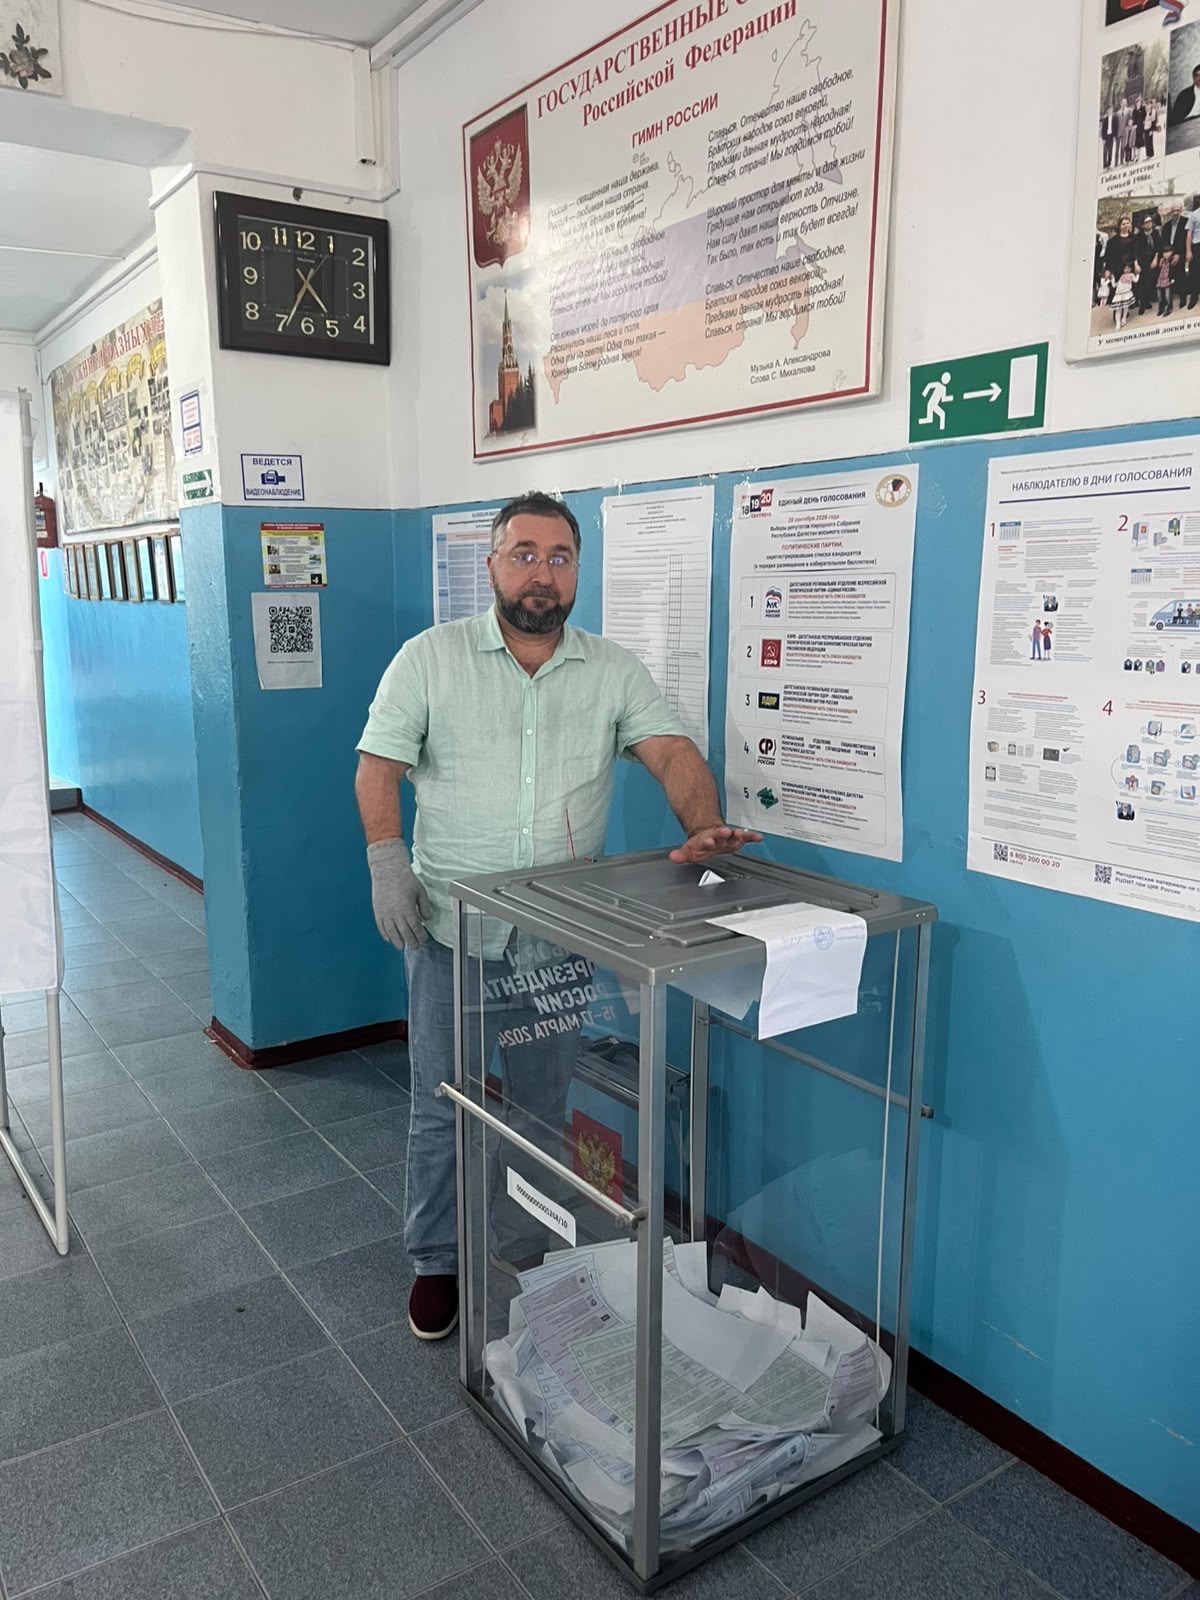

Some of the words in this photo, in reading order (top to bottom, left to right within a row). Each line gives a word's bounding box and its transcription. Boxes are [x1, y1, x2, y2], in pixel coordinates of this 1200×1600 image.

[538, 0, 729, 119] ГОСУДАРСТВЕННЫЕ
[583, 57, 675, 127] Российской
[685, 0, 797, 70] Федерации
[740, 100, 784, 128] Отечество
[786, 89, 807, 107] наше
[809, 69, 854, 97] свободное,
[632, 120, 663, 149] ГИМН
[667, 93, 719, 137] РОССИИ
[743, 121, 773, 143] народов
[774, 113, 793, 132] союз
[708, 151, 742, 174] Предками
[743, 139, 768, 161] данная
[770, 123, 809, 149] мудрость
[811, 99, 852, 128] народная!
[739, 152, 769, 175] страна!
[770, 148, 783, 161] Мы
[785, 132, 822, 156] гордимся
[824, 116, 854, 139] тобой!
[577, 184, 610, 206] священная
[611, 176, 628, 190] наша
[707, 197, 737, 219] Широкий
[738, 187, 770, 208] простор
[771, 180, 785, 196] для
[786, 169, 814, 189] мечты
[816, 167, 821, 176] и
[822, 159, 838, 175] для
[839, 148, 865, 167] жизни
[1107, 181, 1130, 191] семьей
[605, 192, 621, 206] наша
[706, 213, 740, 234] Грядущие
[741, 206, 755, 221] нам
[757, 189, 803, 216] открывают
[803, 181, 824, 197] года.
[706, 237, 721, 250] Нам
[722, 230, 737, 244] силу
[739, 223, 758, 241] дает
[759, 216, 779, 231] наша
[780, 203, 818, 226] верность
[820, 187, 859, 211] Отчизне.
[240, 232, 261, 250] 10
[272, 227, 286, 245] 11
[295, 230, 315, 250] 12
[707, 252, 718, 266] Так
[719, 247, 739, 261] было,
[740, 241, 755, 255] так
[756, 233, 774, 248] есть
[776, 231, 781, 241] и
[782, 226, 799, 241] так
[800, 216, 826, 237] будет
[827, 201, 859, 225] всегда!
[328, 236, 333, 253] 1
[352, 248, 365, 266] 2
[244, 267, 257, 284] 9
[705, 280, 733, 295] Славься,
[736, 265, 779, 286] Отечество
[781, 259, 801, 273] наше
[802, 243, 846, 266] свободное,
[353, 282, 365, 299] 3
[705, 294, 737, 311] Братских
[739, 284, 768, 301] народов
[770, 277, 788, 291] союз
[705, 309, 738, 326] Предками
[739, 302, 763, 318] данная
[765, 291, 802, 311] мудрость
[804, 274, 844, 298] народная!
[246, 302, 259, 320] 8
[705, 322, 733, 339] Славься,
[736, 314, 764, 333] страна!
[765, 311, 777, 324] Мы
[779, 301, 815, 321] гордимся
[816, 291, 846, 310] тобой!
[275, 314, 288, 332] 7
[301, 318, 314, 334] 6
[326, 320, 339, 337] 5
[353, 316, 366, 332] 4
[624, 338, 634, 347] ты
[636, 331, 657, 343] такая
[1106, 329, 1160, 343] мемориальной
[1162, 325, 1184, 334] доски
[751, 361, 774, 374] Музыка
[775, 358, 781, 368] А.
[783, 348, 831, 366] Александрова
[750, 373, 770, 384] Слова
[771, 370, 778, 380] С.
[780, 363, 816, 378] Михалкова
[252, 458, 292, 466] ВЕДЕТСЯ
[1012, 477, 1081, 492] НАБЛЮДАТЕЛЮ
[1083, 476, 1089, 486] В
[1091, 474, 1112, 487] ДНИ
[1115, 467, 1192, 483] ГОЛОСОВАНИЯ
[246, 488, 301, 496] ВИДЕОНАБЛЮДЕНИЕ
[761, 493, 770, 503] 20
[778, 497, 803, 507] ЕДИНЫЙ
[804, 495, 819, 505] ДЕНЬ
[820, 492, 866, 502] ГОЛОСОВАНИЯ
[742, 506, 749, 515] 18
[751, 499, 759, 509] 19
[837, 520, 860, 528] Собрания
[990, 522, 996, 537] 1
[1118, 515, 1129, 532] 2
[750, 596, 753, 608] 1
[747, 646, 751, 657] 2
[746, 694, 750, 706] 3
[977, 690, 986, 705] 3
[1102, 700, 1113, 716] 4
[744, 743, 749, 754] 4
[744, 787, 749, 799] 5
[1115, 877, 1134, 885] РЦОИТ
[1116, 871, 1154, 882] Методические
[1156, 879, 1186, 889] материалы
